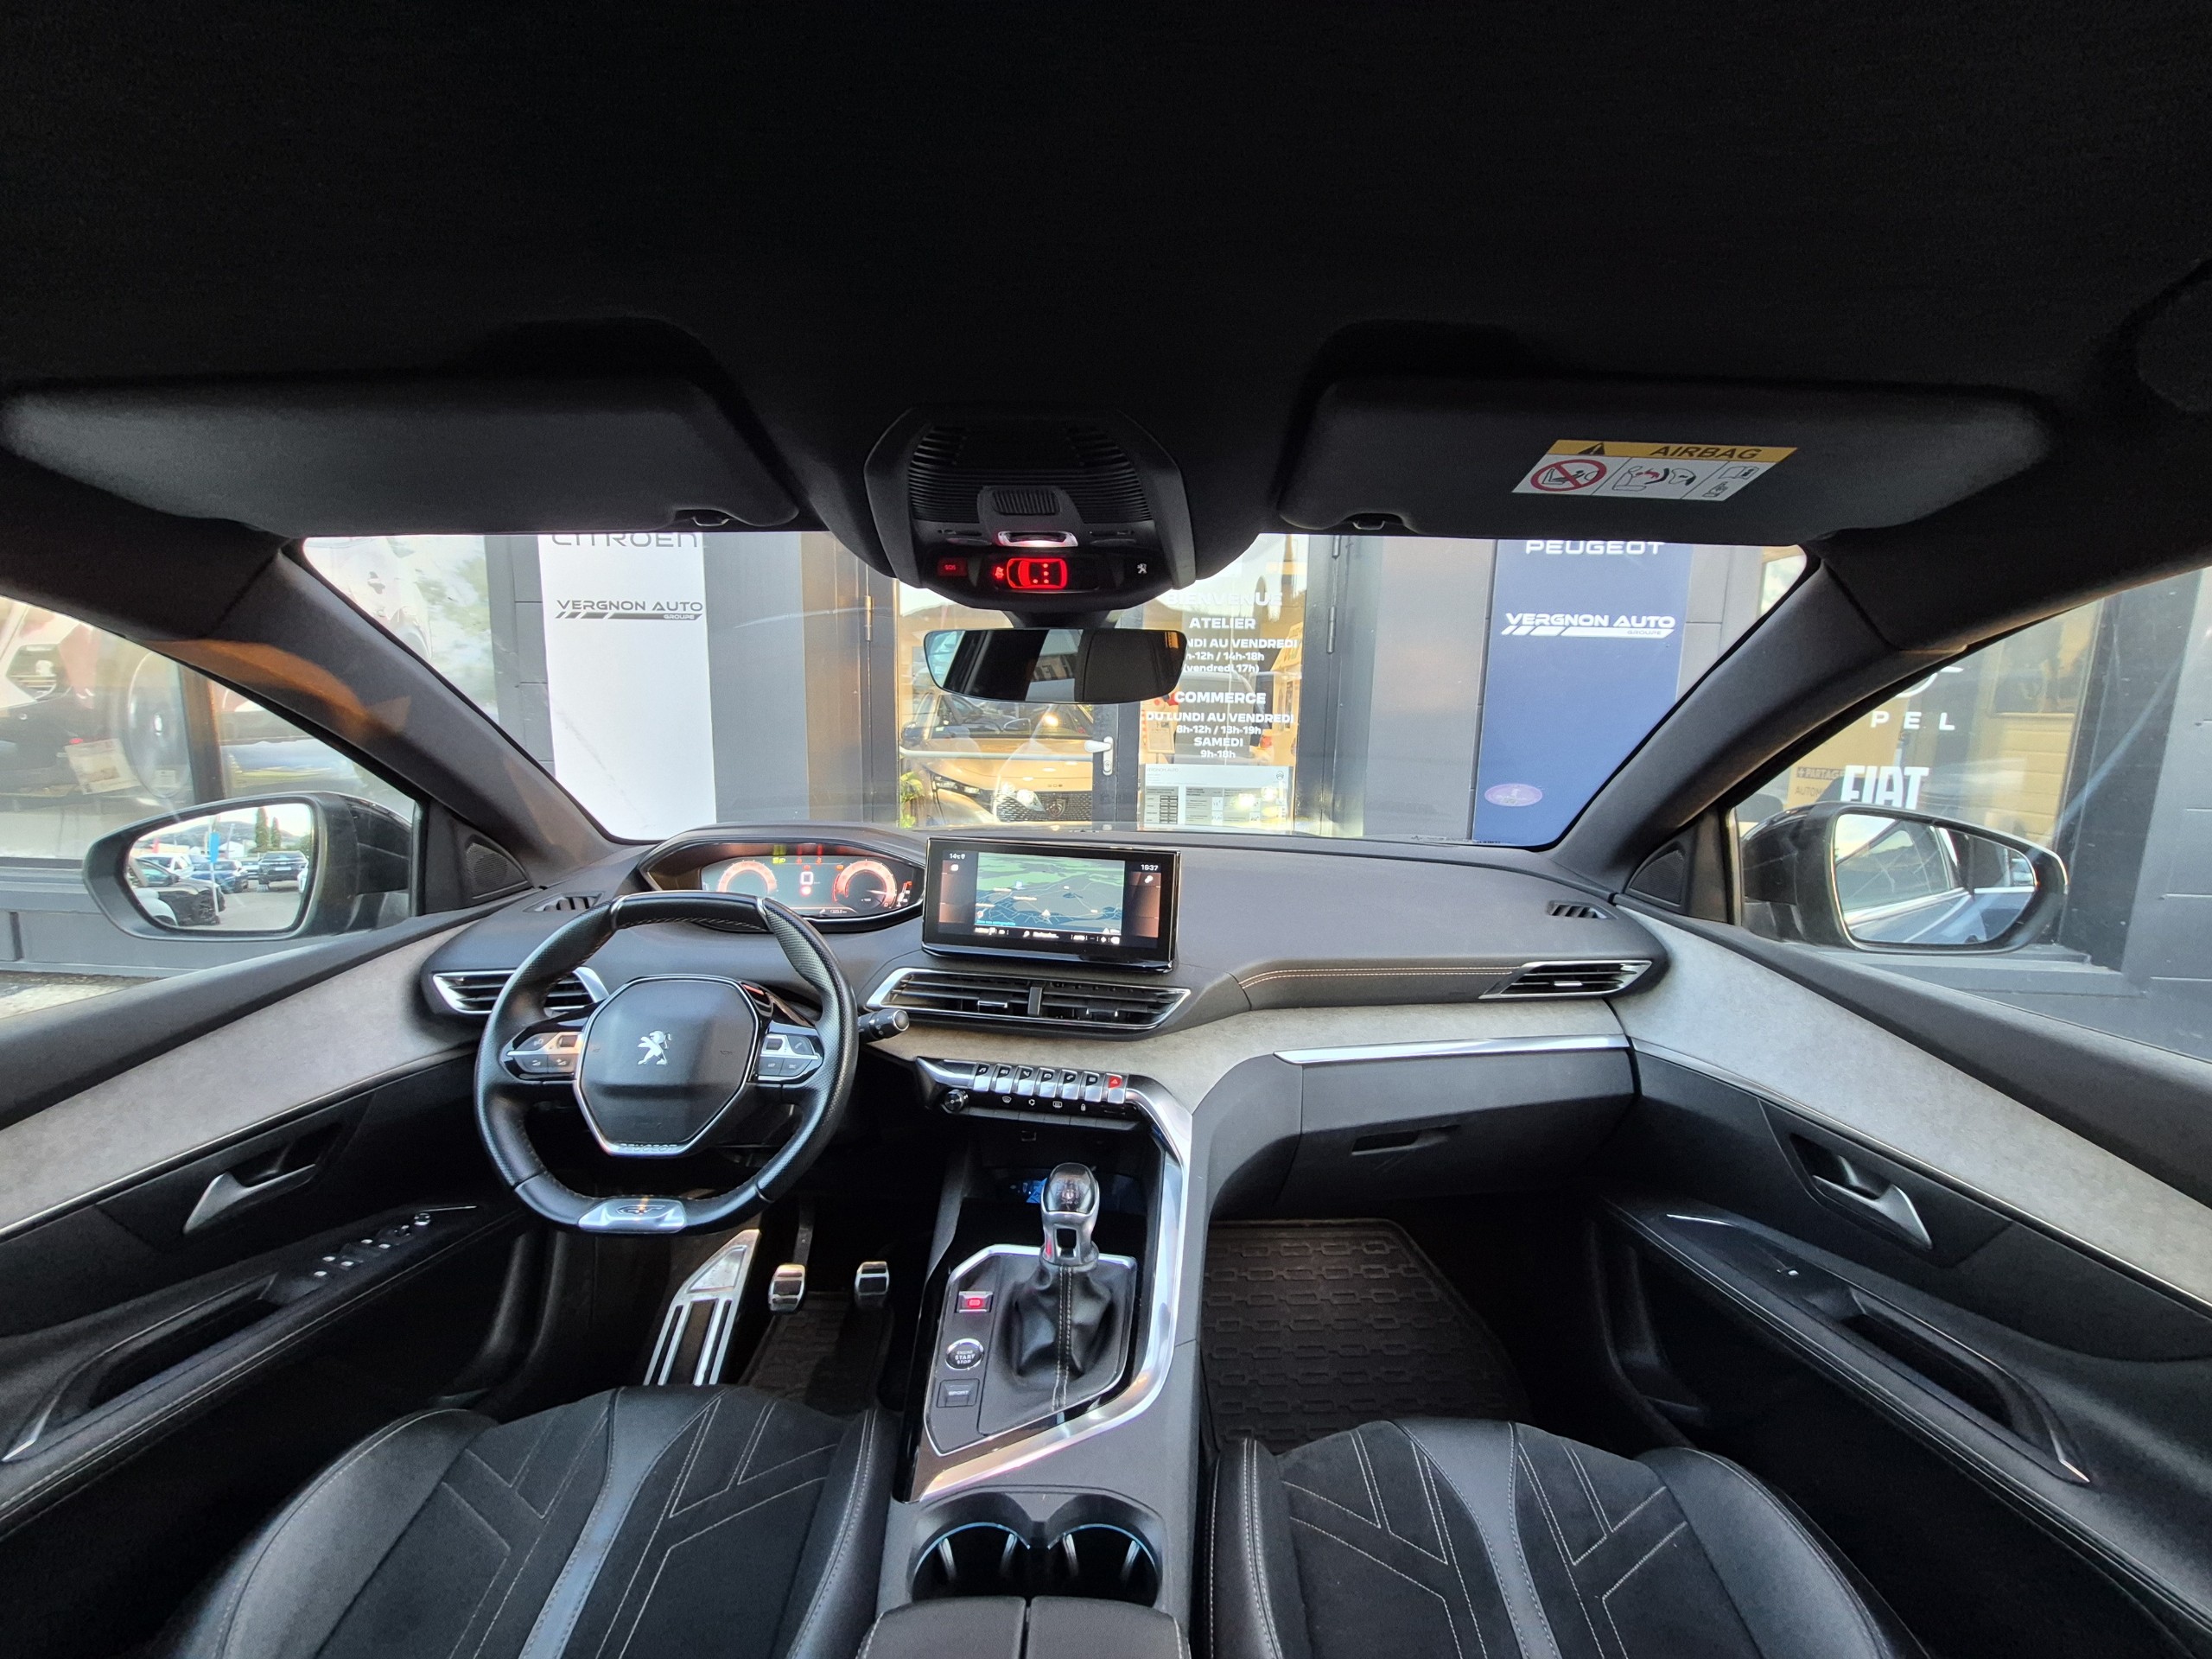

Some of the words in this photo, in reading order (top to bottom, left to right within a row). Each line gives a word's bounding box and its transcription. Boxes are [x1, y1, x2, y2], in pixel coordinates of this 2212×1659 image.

[1649, 445, 1762, 460] AIRBAG
[1525, 539, 1666, 555] PEUGEOT
[1167, 592, 1283, 606] BIENVENUE
[556, 600, 645, 611] VERGNON
[652, 601, 703, 612] AUTO
[1189, 617, 1256, 630] ATELIER
[1505, 613, 1610, 627] VERGNON
[1612, 615, 1676, 628] AUTO
[1186, 638, 1207, 648] NDI
[1210, 638, 1229, 648] AU
[1231, 638, 1298, 649] VENDREDI
[1185, 651, 1214, 661] h-12h
[1223, 651, 1265, 661] 14h-18h
[1173, 691, 1267, 705] COMMERCE
[1146, 712, 1167, 721] DU
[1169, 712, 1205, 722] LUNDI
[1207, 713, 1226, 722] AU
[1229, 713, 1294, 723] VENDREDI
[1176, 725, 1211, 734] 8h-12h
[1222, 725, 1262, 735] 13h-19h
[1193, 737, 1244, 747] SAMEDI
[1200, 749, 1236, 759] 9h-18h
[1840, 765, 1929, 810] FIAT
